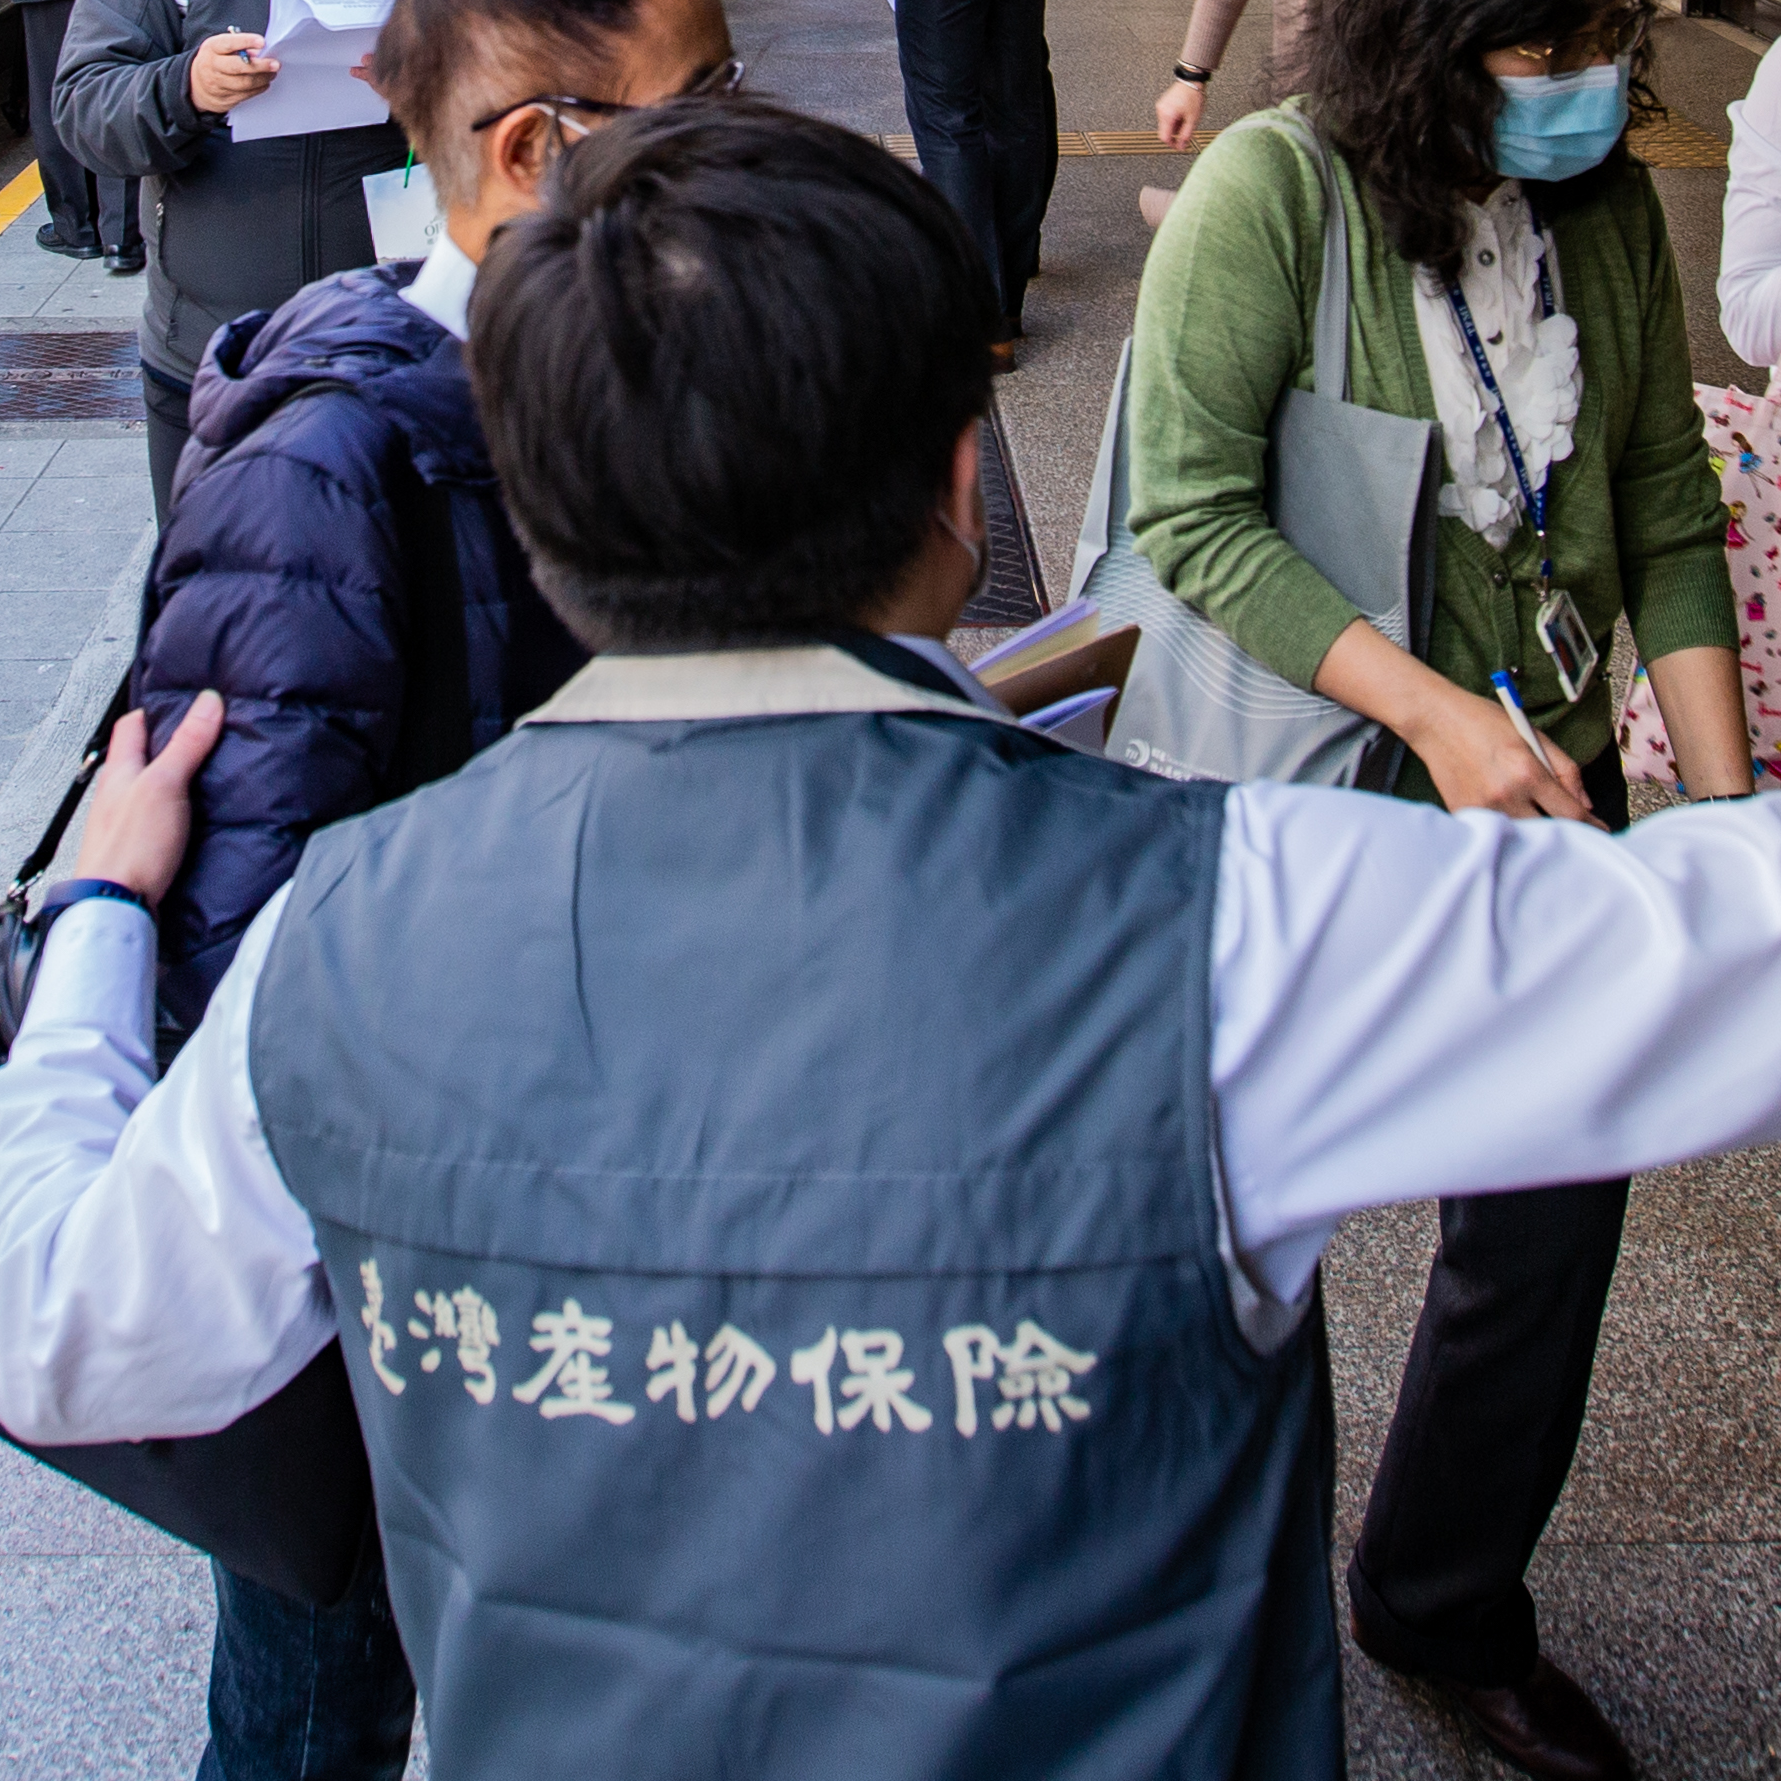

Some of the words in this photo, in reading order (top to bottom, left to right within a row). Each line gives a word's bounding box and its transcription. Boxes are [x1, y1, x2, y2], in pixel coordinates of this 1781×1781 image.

[359, 1255, 1098, 1439] 臺灣產物保險
